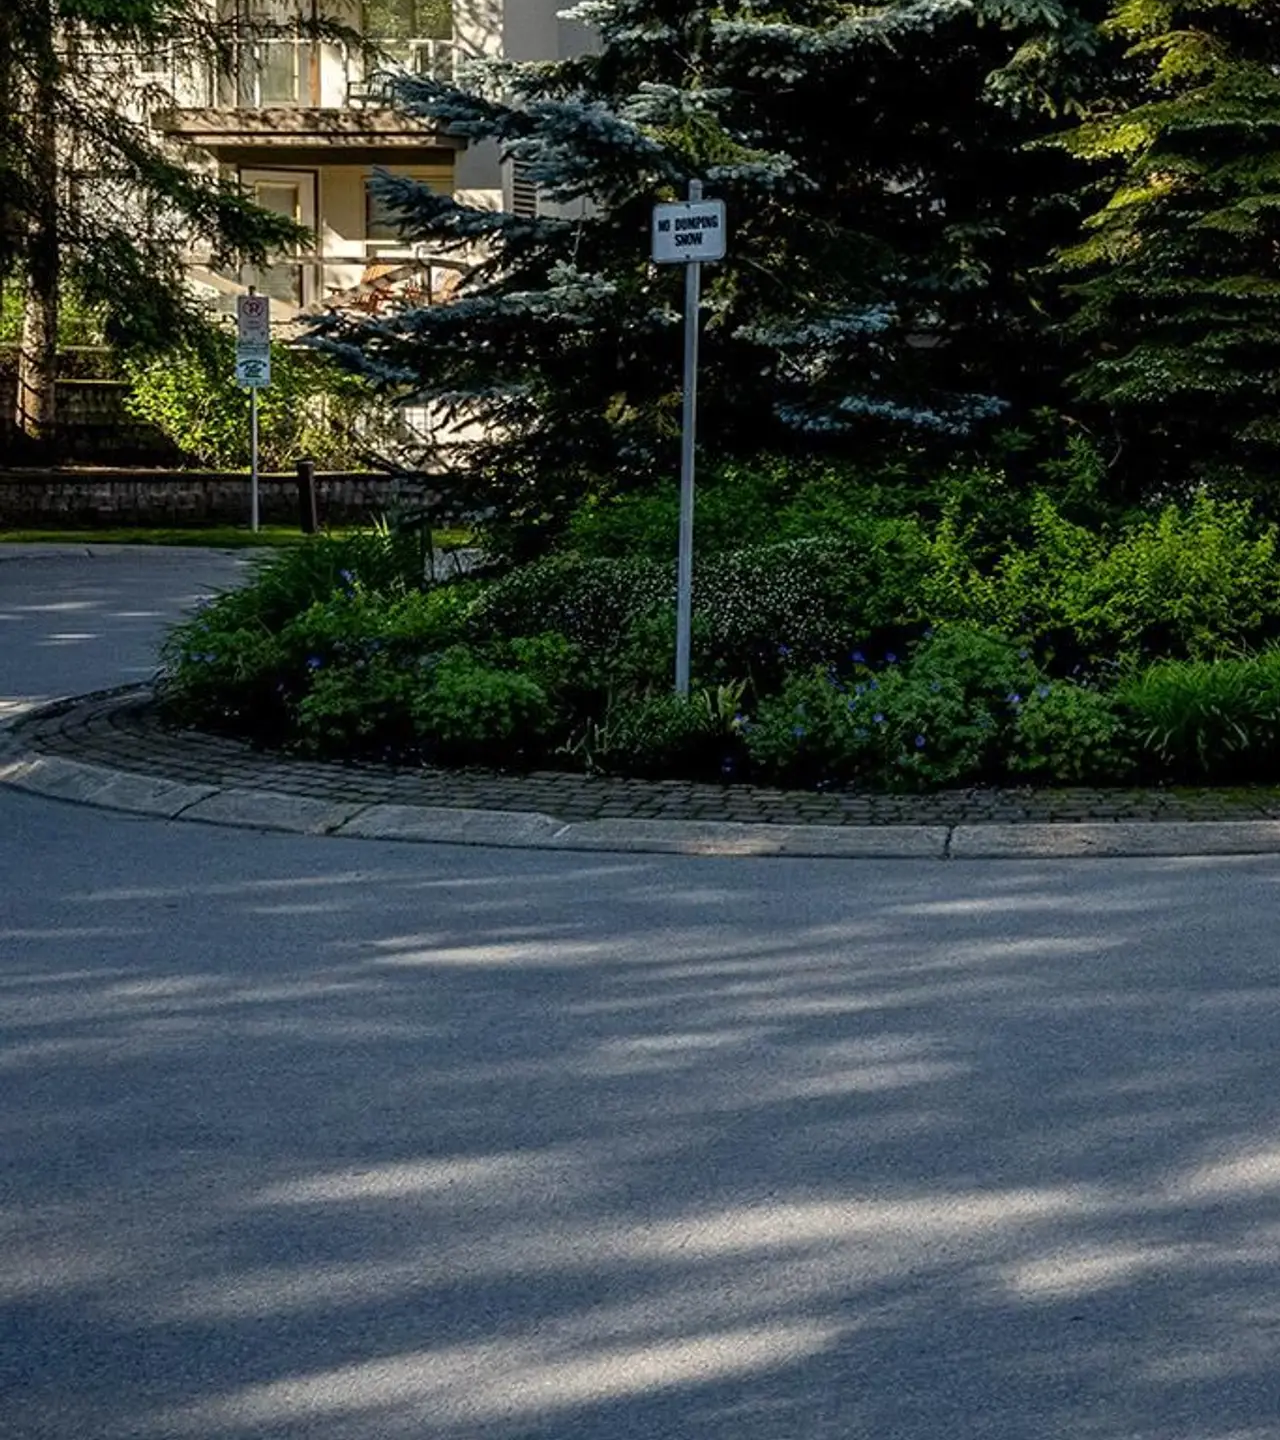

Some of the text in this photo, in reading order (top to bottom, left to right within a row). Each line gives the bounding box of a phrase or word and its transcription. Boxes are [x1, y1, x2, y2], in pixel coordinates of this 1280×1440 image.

[658, 215, 718, 232] NO DUMPING
[675, 232, 702, 246] SNOW
